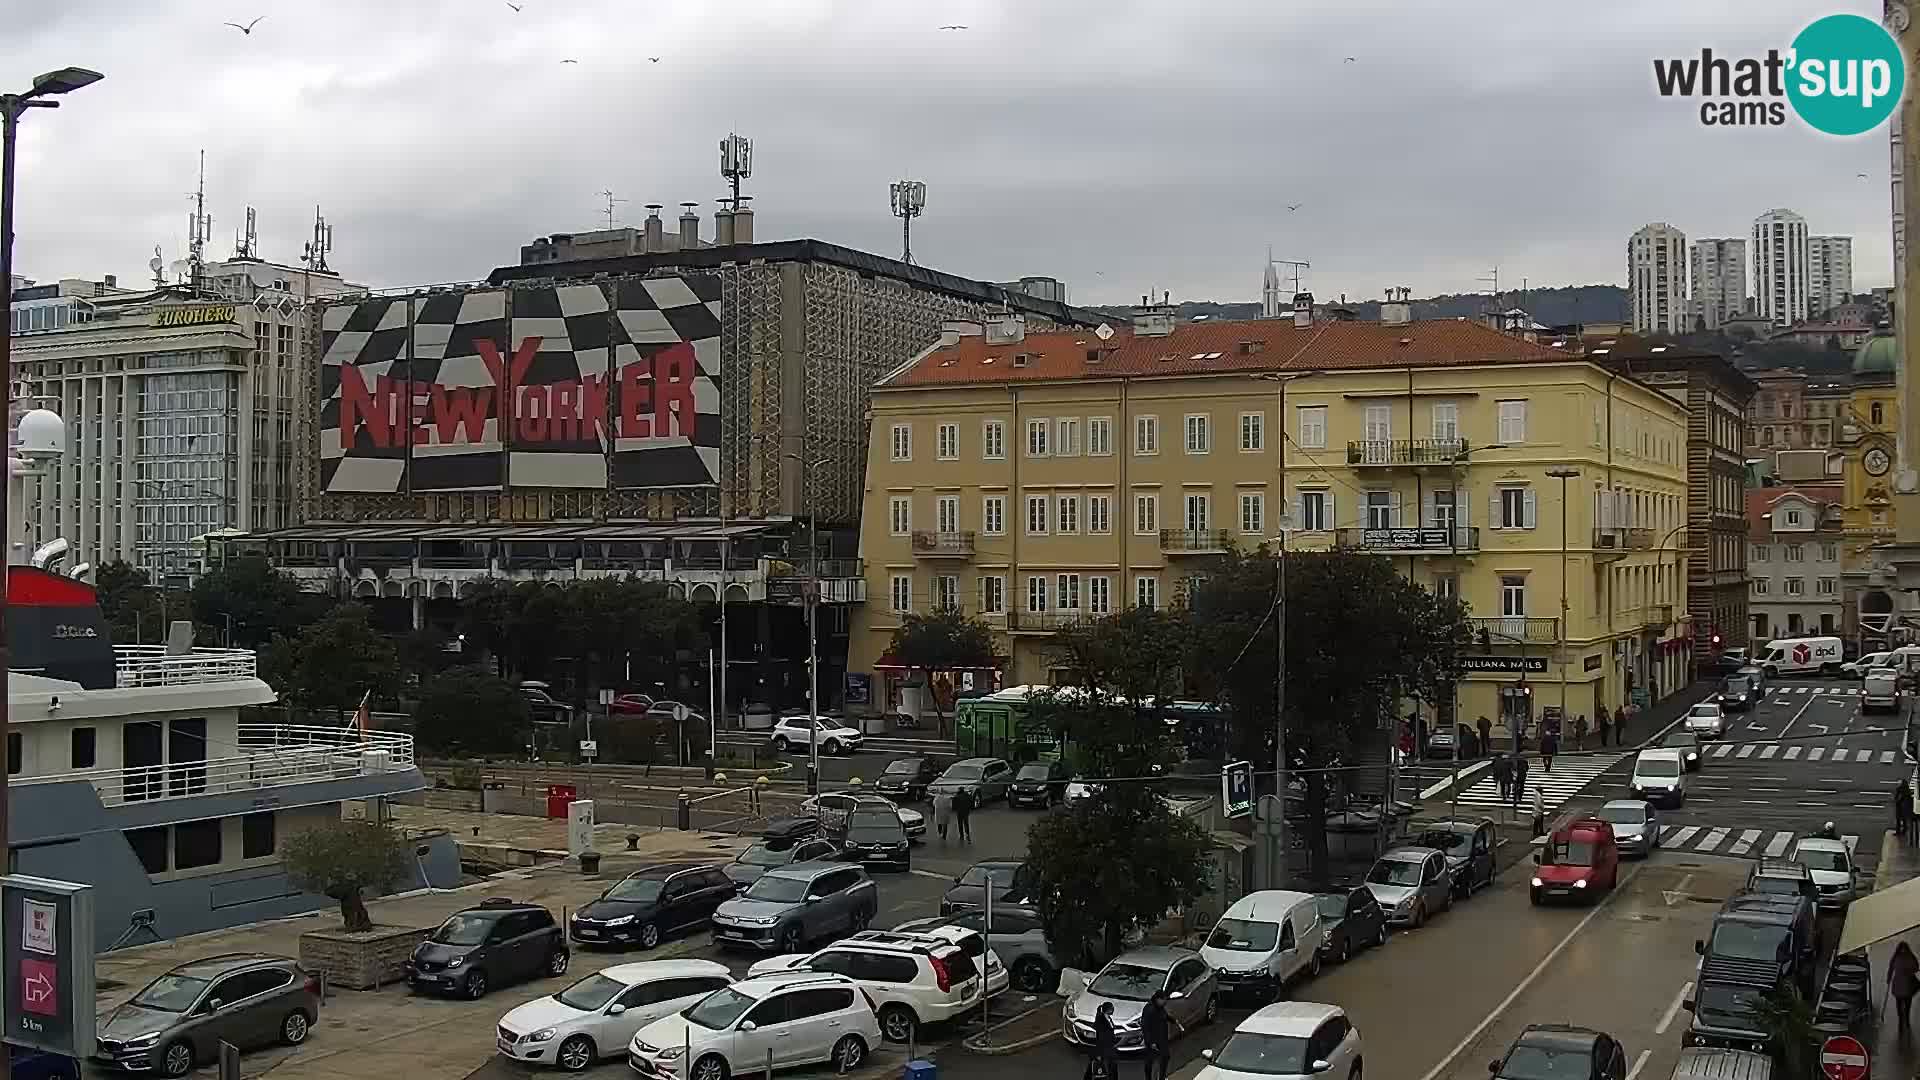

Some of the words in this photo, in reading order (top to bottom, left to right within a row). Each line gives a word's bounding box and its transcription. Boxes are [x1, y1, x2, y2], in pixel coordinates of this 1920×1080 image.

[341, 359, 494, 448] NEW
[474, 336, 697, 442] YORKER
[1461, 660, 1506, 668] JULIANA
[1510, 661, 1543, 669] NAILS
[22, 1017, 29, 1029] 5
[29, 1018, 43, 1032] km
